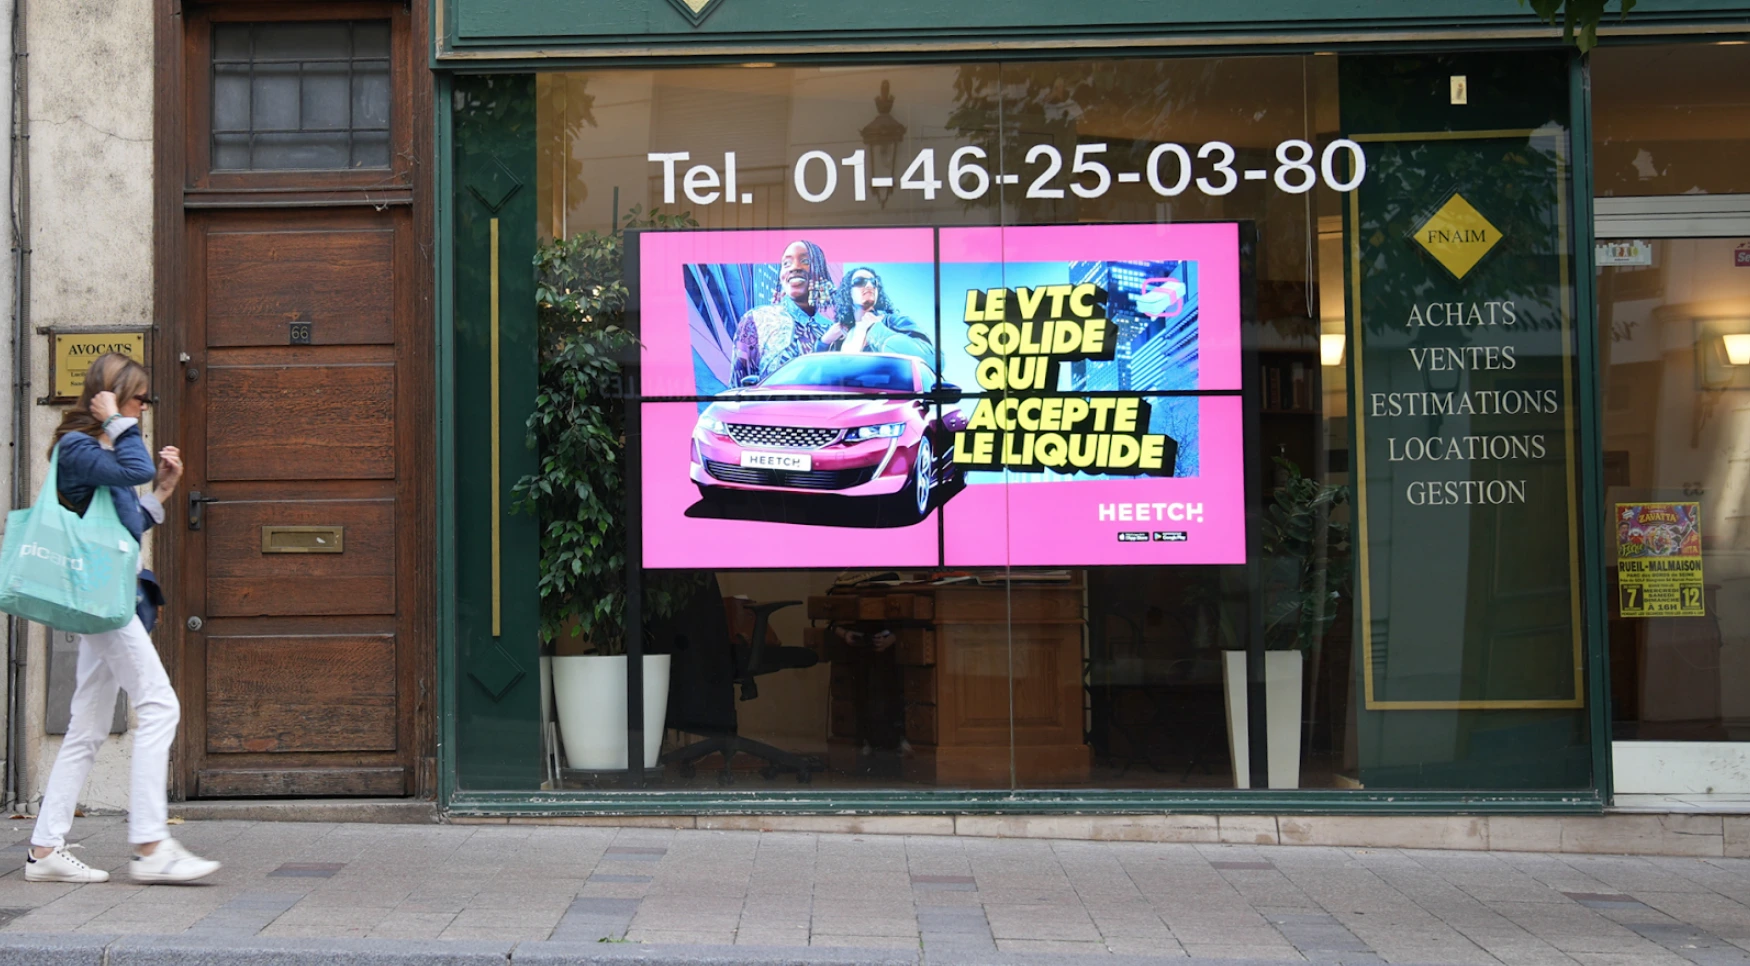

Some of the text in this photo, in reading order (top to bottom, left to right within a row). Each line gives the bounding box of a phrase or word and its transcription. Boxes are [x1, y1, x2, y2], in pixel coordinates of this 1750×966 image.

[648, 138, 1367, 205] Tel. 01-46-25-03-80
[1427, 229, 1487, 244] FNAIM
[964, 283, 1096, 322] LE VTC
[1405, 301, 1517, 327] ACHATS
[291, 325, 309, 340] 66
[964, 319, 1107, 356] SOLIDE
[68, 343, 132, 355] AVOCATS
[1408, 346, 1517, 371] VENTES
[975, 356, 1049, 390] QUI
[966, 397, 1140, 432] ACCEPTE
[1370, 389, 1558, 417] ESTIMATIONS
[953, 432, 1166, 469] LE LIQUIDE
[1387, 434, 1547, 462] LOCATIONS
[750, 456, 800, 468] HEETCH
[1406, 480, 1527, 505] GESTION
[1098, 502, 1204, 523] HEETCH
[1638, 512, 1677, 524] ZAVATTA
[19, 541, 84, 571] picard
[1619, 560, 1702, 572] RUEIL-MALMAISON
[1627, 589, 1637, 608] 7
[1682, 588, 1700, 607] 12
